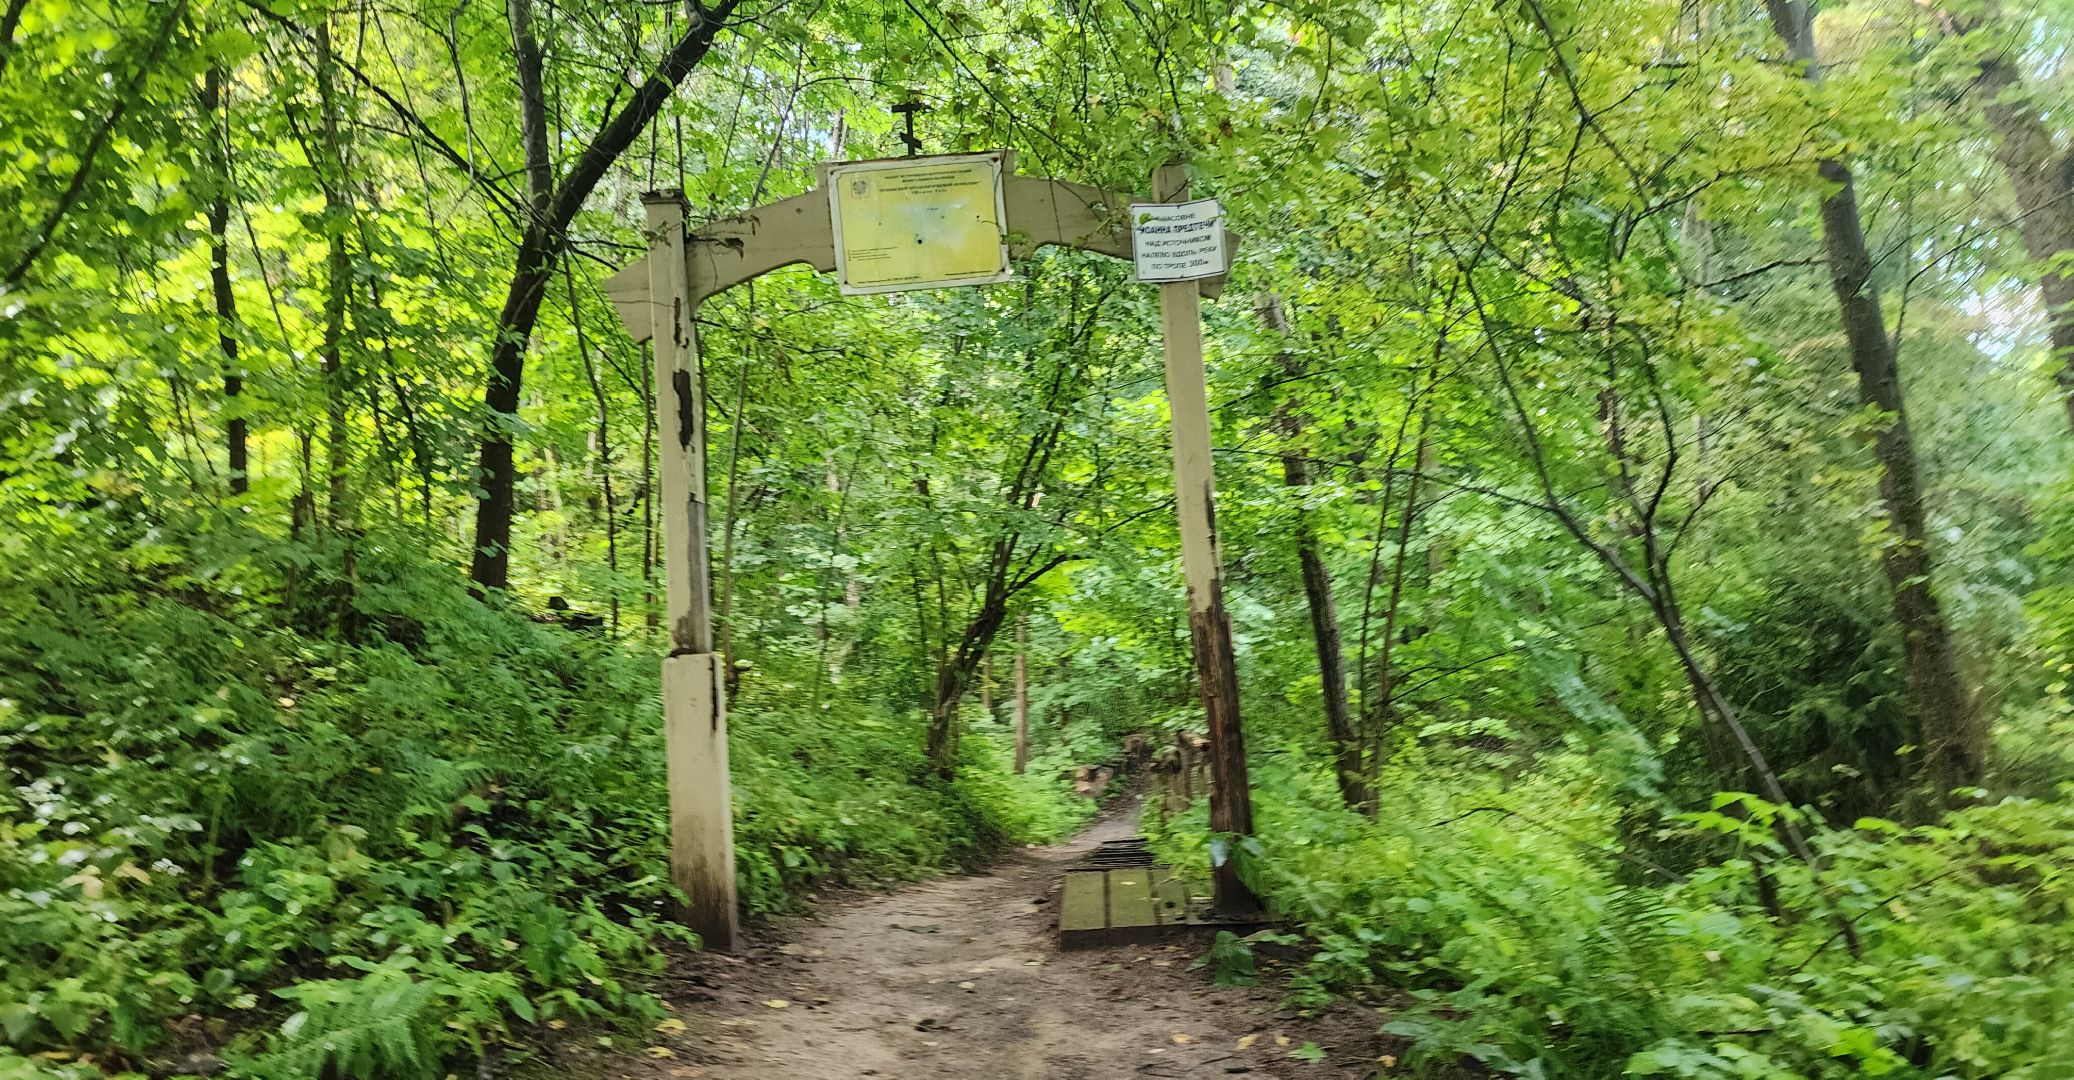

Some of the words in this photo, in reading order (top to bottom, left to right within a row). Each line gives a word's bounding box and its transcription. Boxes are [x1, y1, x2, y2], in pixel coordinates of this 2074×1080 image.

[1173, 220, 1214, 233] ПРЕДТЕЧИ
[1162, 235, 1211, 246] ИСТОЧНИКОМ
[1172, 249, 1198, 258] ВДОЛЬ
[1199, 246, 1217, 254] РЕКИ
[1152, 262, 1163, 270] ПО
